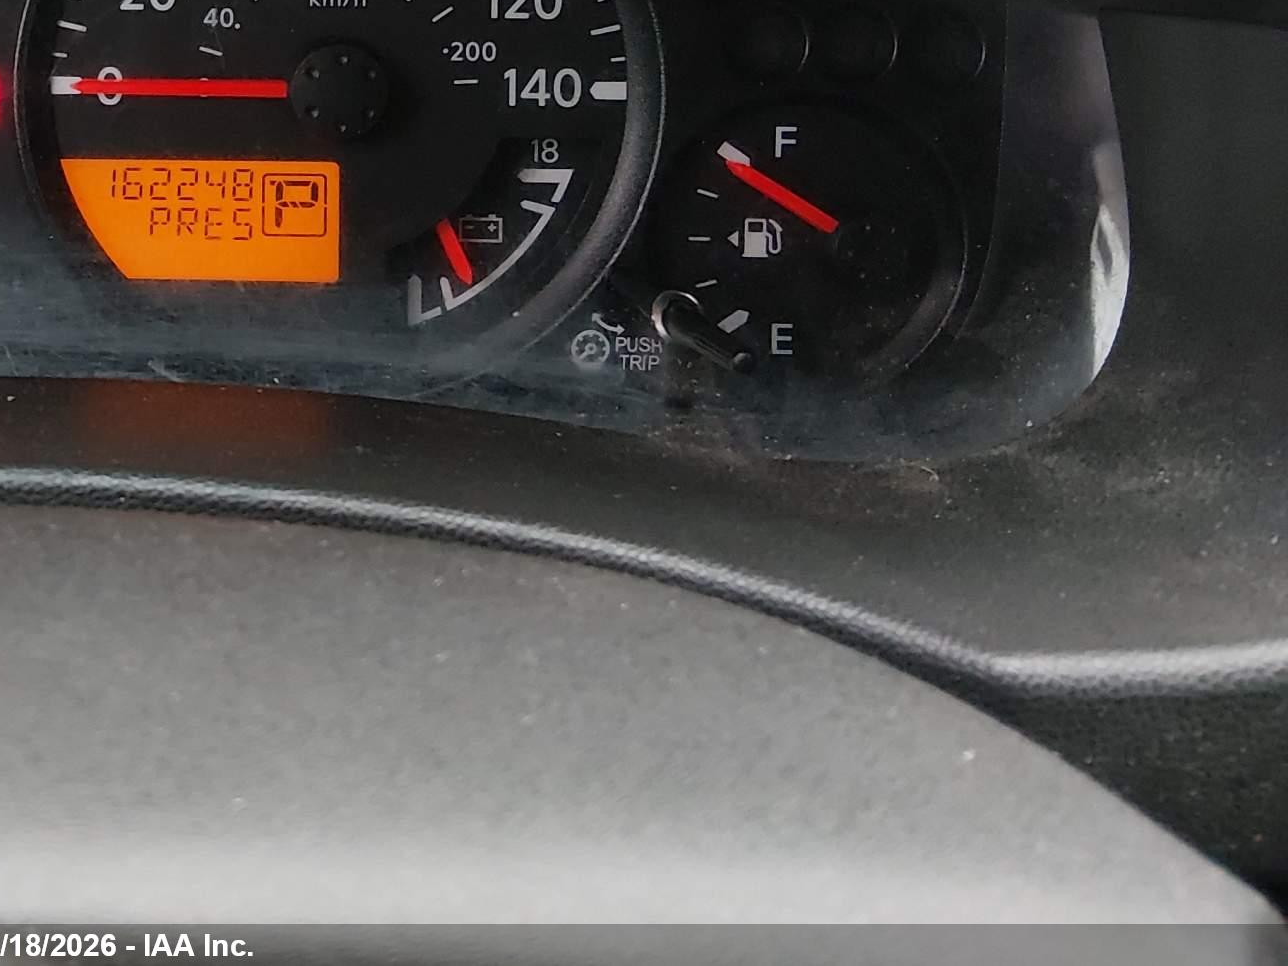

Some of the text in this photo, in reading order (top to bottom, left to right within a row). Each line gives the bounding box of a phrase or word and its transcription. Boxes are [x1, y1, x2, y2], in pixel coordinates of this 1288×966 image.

[450, 41, 497, 62] 200
[503, 68, 582, 108] 140
[532, 138, 560, 164] 18
[775, 126, 798, 158] F
[111, 167, 254, 202] 162248
[269, 179, 319, 229] P
[149, 206, 254, 241] PRES
[615, 336, 663, 354] PUSH
[771, 324, 794, 355] E
[619, 354, 660, 371] TRIP
